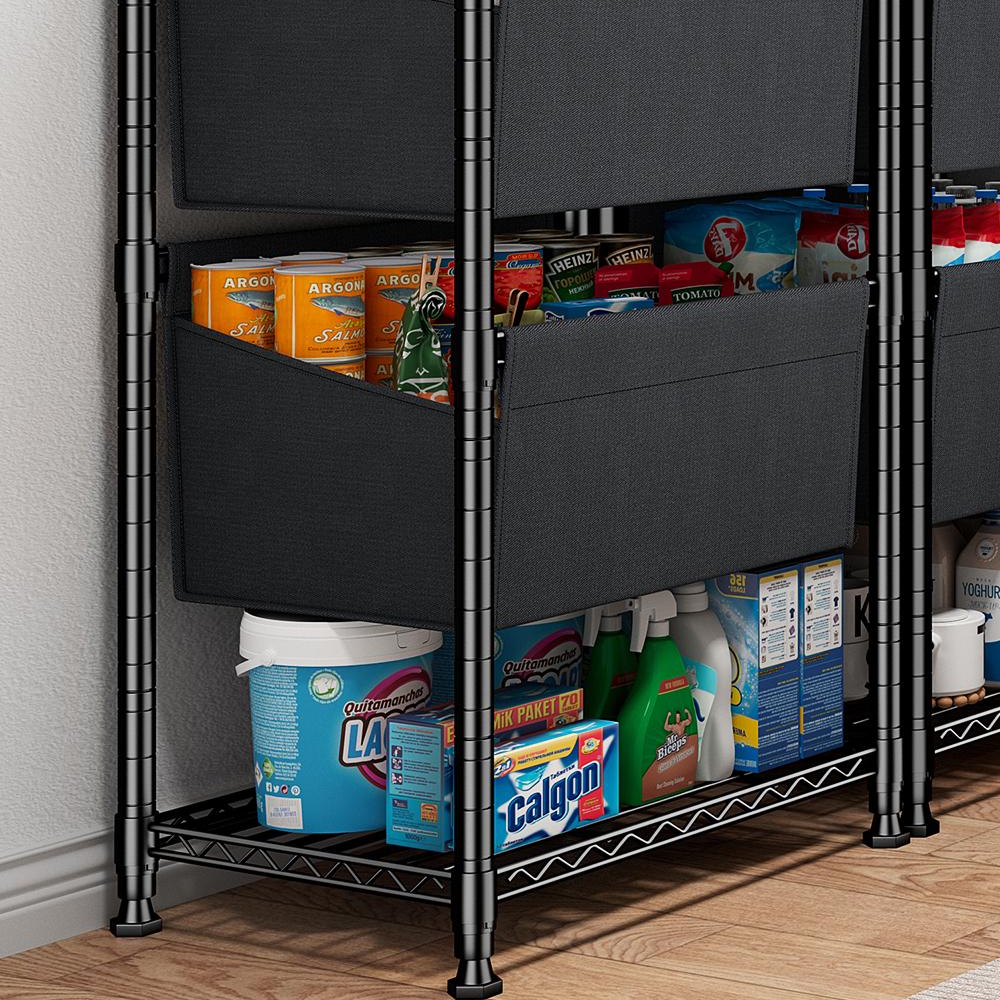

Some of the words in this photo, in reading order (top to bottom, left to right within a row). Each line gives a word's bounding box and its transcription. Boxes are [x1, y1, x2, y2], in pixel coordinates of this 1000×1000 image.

[552, 251, 593, 273] HEINZ
[610, 248, 650, 266] HEINZ
[672, 288, 722, 302] TOMATO
[504, 646, 577, 674] Quitamanchas
[344, 686, 424, 715] Quitamanchas
[518, 698, 557, 724] PAKET
[562, 692, 579, 708] 70
[656, 734, 688, 761] Biceps
[666, 734, 678, 744] Mr
[507, 760, 601, 833] Calgon
